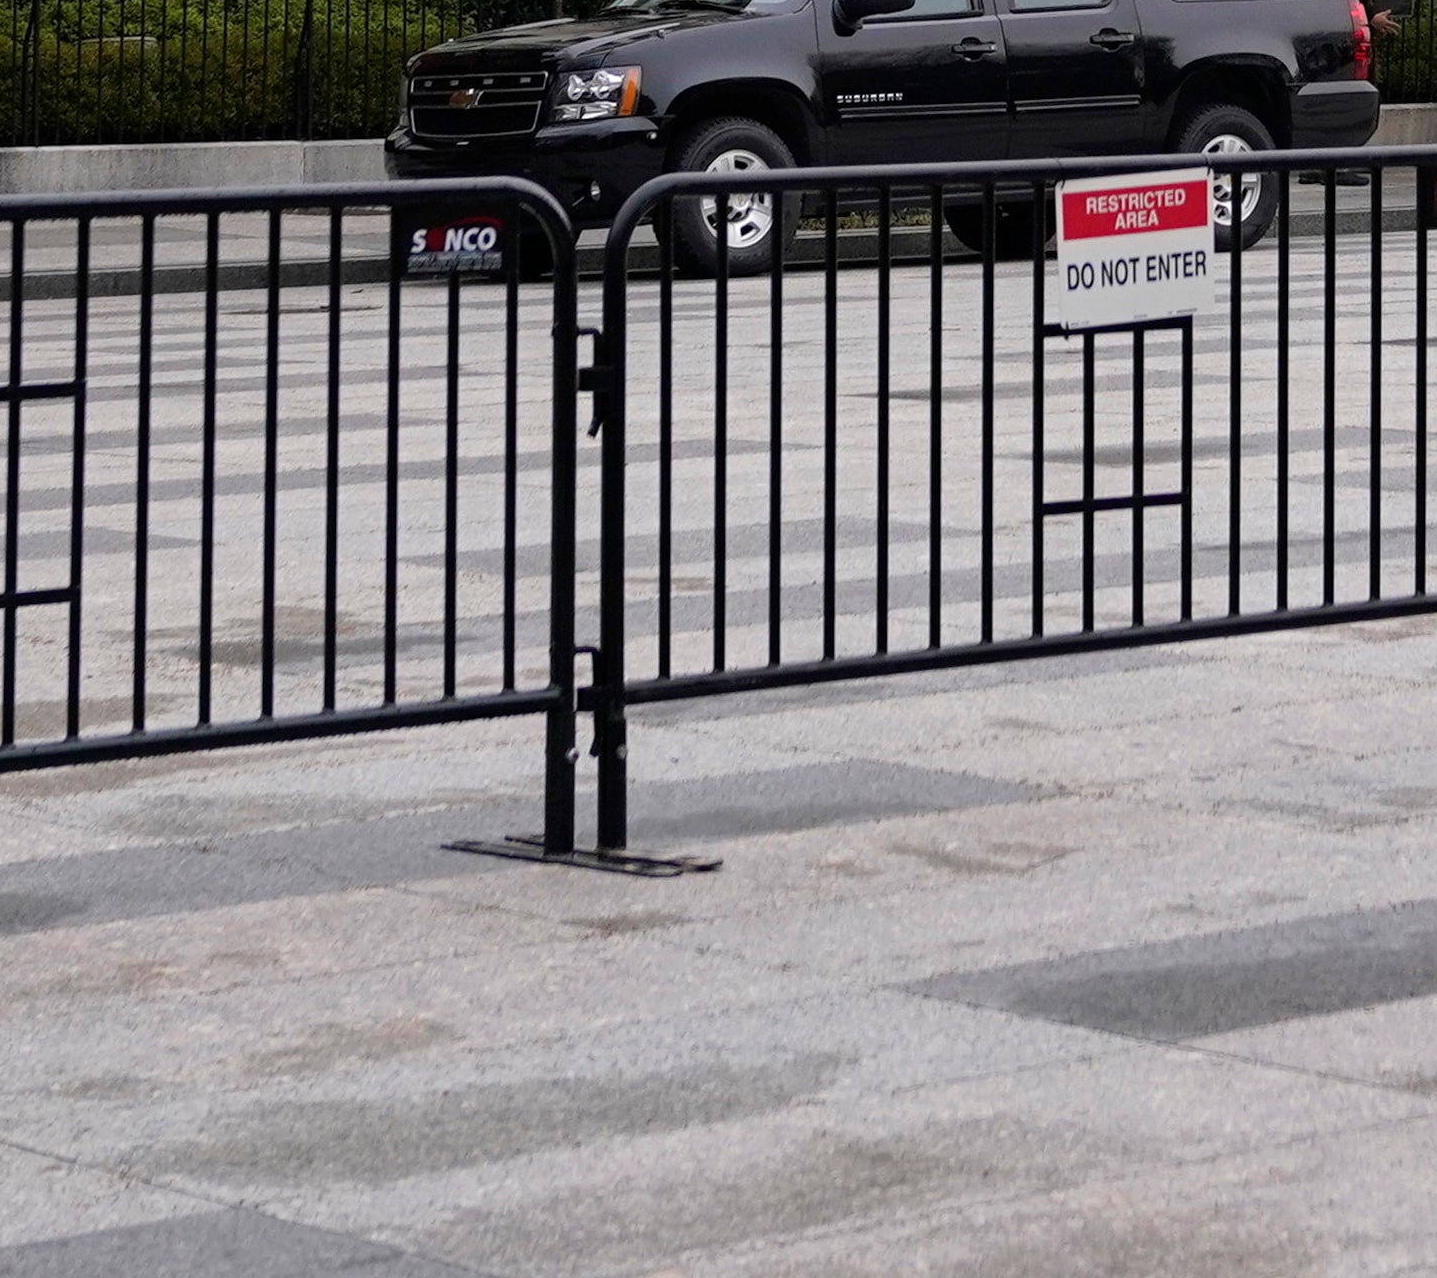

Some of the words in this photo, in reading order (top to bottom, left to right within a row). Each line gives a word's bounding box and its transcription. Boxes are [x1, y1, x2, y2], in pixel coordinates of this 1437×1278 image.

[836, 92, 903, 104] SUBURBAN
[1086, 188, 1186, 214] RESTRICTED
[1114, 209, 1159, 231] AREA
[1067, 262, 1095, 291] DO
[1101, 257, 1140, 287] NOT
[1146, 250, 1206, 282] ENTER
